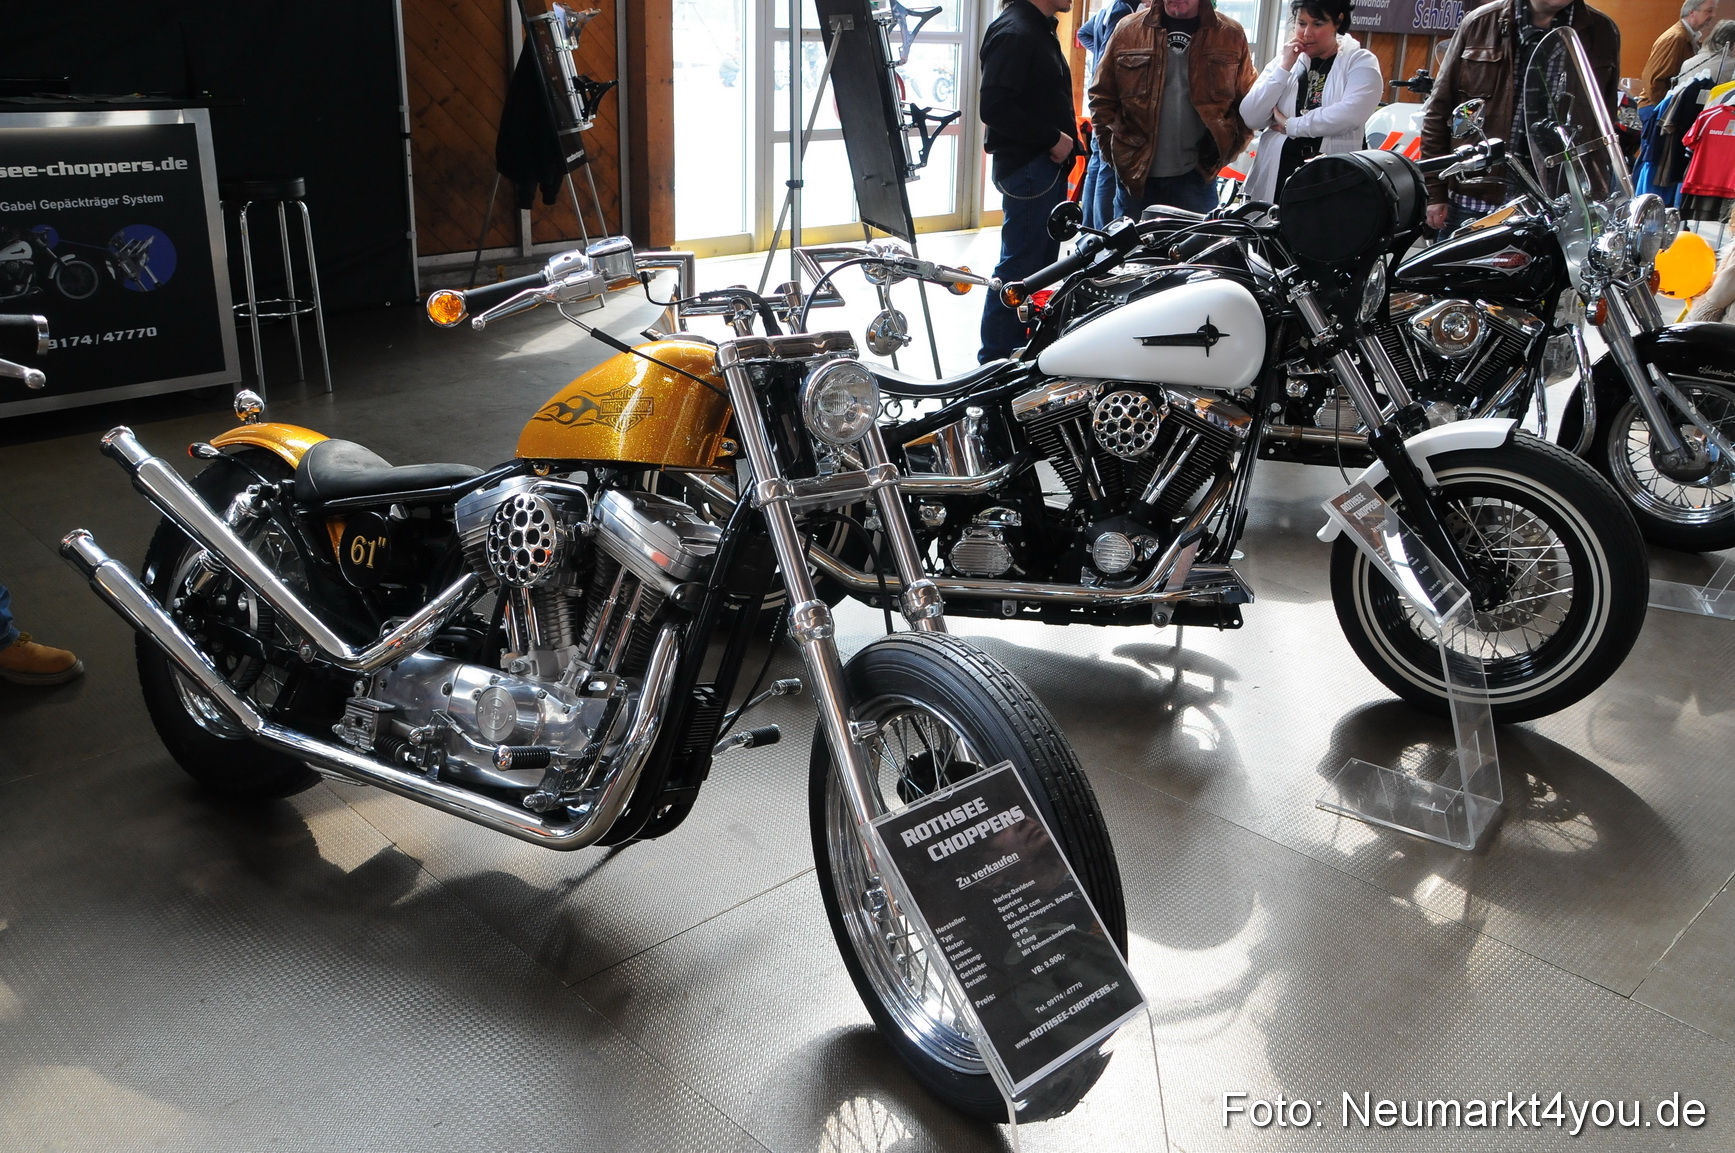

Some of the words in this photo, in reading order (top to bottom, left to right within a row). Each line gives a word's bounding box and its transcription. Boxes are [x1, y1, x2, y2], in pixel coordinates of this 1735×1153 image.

[0, 200, 37, 212] Gabel
[40, 196, 119, 211] Gepäckträger
[122, 194, 164, 206] System
[350, 535, 387, 569] 61"
[900, 796, 989, 848] ROTHSEE
[927, 805, 1026, 862] CHOPPERS
[956, 876, 972, 889] Zu
[971, 852, 1020, 880] verkaufen
[935, 915, 967, 935] Hersteller:
[992, 879, 1036, 905] Harley-Davidson
[940, 933, 954, 944] Typ:
[997, 896, 1023, 913] Sportster
[945, 939, 965, 953] Motor:
[1002, 911, 1018, 922] EVO,
[1017, 903, 1029, 914] 883
[1028, 898, 1041, 911] ccm
[950, 946, 973, 962] Umbau:
[1006, 900, 1057, 931] Rothsee-Choppers,
[1054, 890, 1074, 905] Bobber
[954, 952, 982, 971] Leistung:
[1011, 932, 1021, 940] 60
[1019, 926, 1029, 937] PS
[960, 962, 987, 980] Getriebe:
[1016, 941, 1022, 949] 5
[1021, 934, 1037, 947] Gang
[964, 973, 988, 989] Details:
[1021, 946, 1032, 957] Mit
[1031, 923, 1077, 952] Rahmenänderung
[975, 993, 996, 1009] Preis:
[1031, 965, 1045, 976] VB:
[1043, 953, 1067, 969] 9.900,-
[1034, 1003, 1047, 1014] Tel.
[1046, 992, 1064, 1008] 09174
[1066, 981, 1083, 996] 47770
